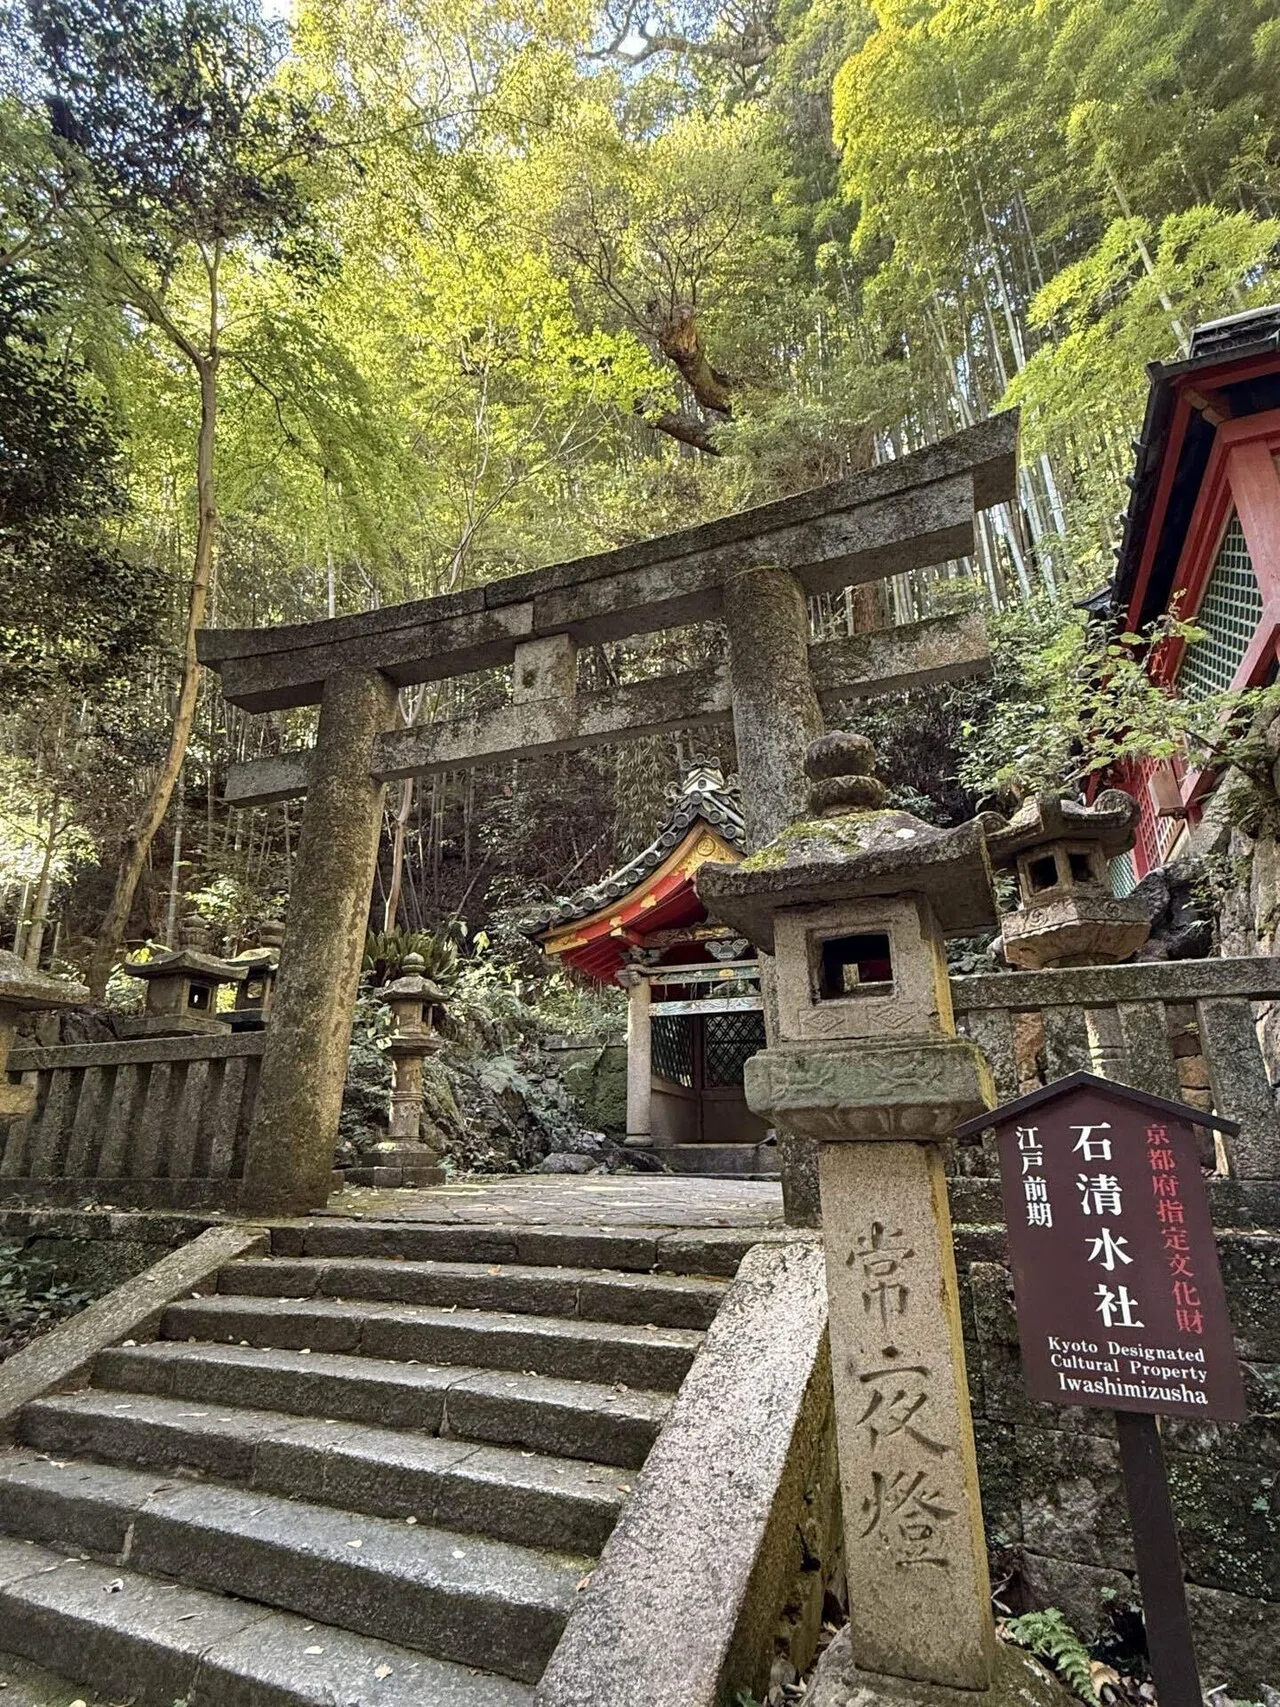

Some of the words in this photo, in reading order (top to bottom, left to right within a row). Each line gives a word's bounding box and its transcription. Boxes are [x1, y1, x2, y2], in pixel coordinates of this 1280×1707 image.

[1016, 1126, 1053, 1228] 江戸前期
[1069, 1121, 1145, 1328] 石清水社
[1144, 1123, 1204, 1335] 京都府指定文化財
[845, 1221, 958, 1569] 常夜燈
[1048, 1336, 1098, 1353] Kyoto
[1107, 1341, 1205, 1362] Designated
[1051, 1353, 1119, 1373] Cultural
[1130, 1361, 1207, 1382] Property
[1059, 1373, 1209, 1405] Iwashimizusha
